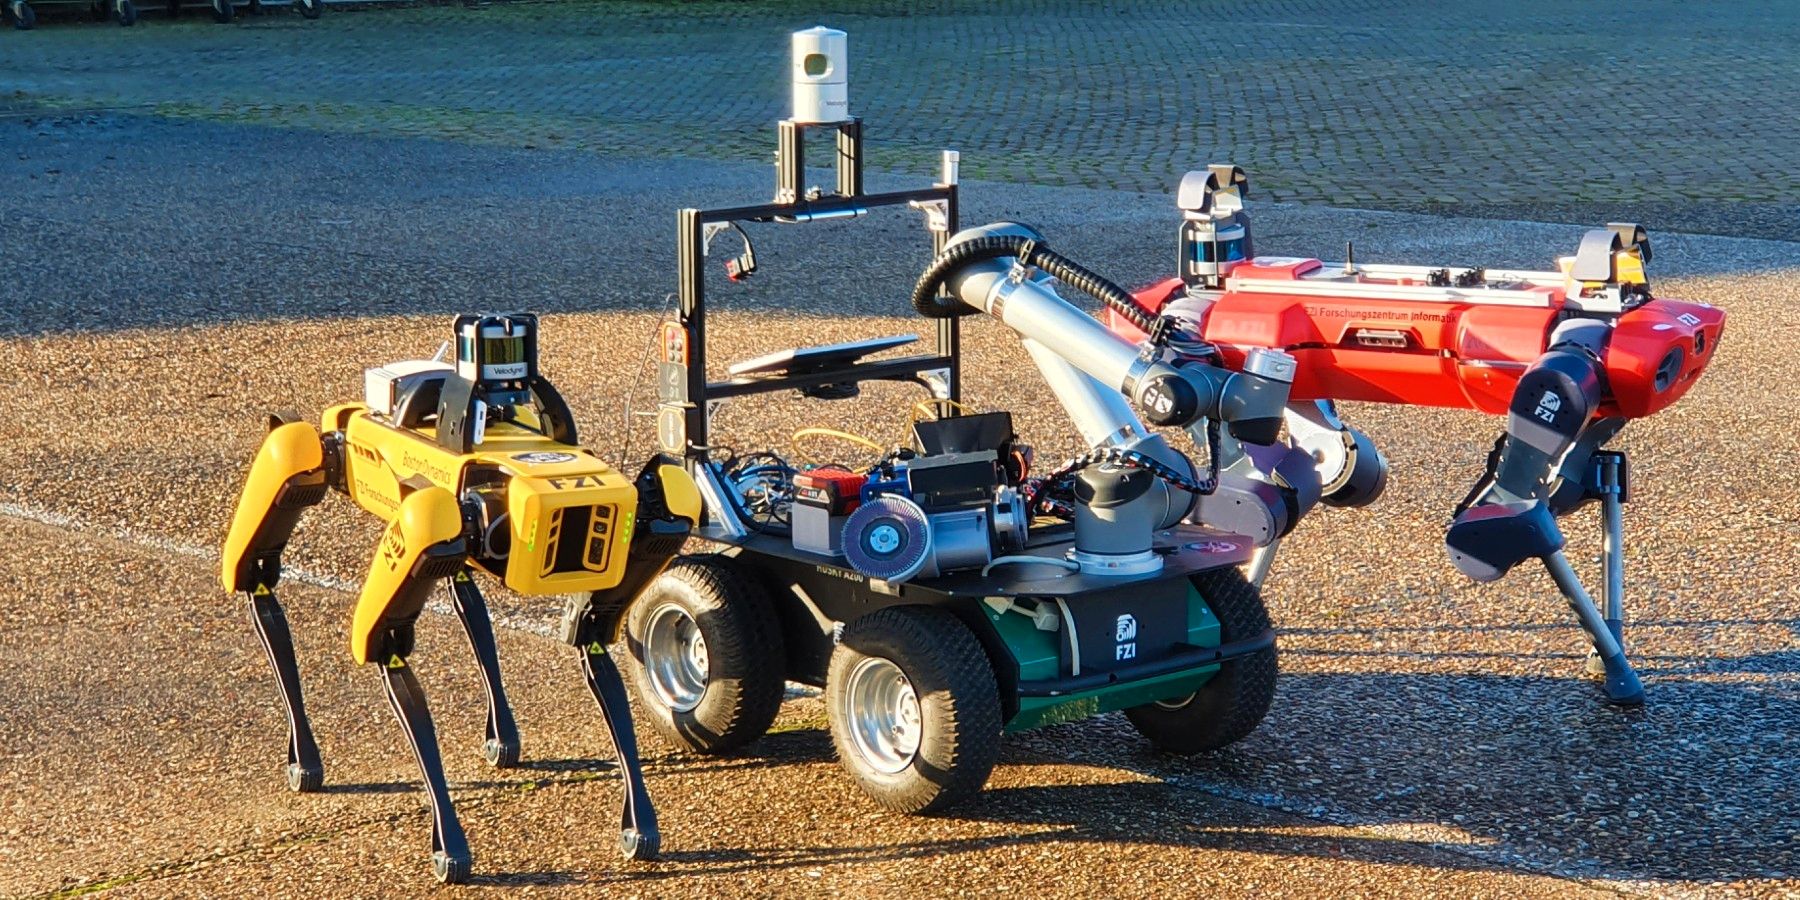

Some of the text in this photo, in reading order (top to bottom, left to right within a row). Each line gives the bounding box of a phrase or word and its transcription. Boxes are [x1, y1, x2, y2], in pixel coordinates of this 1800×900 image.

[1319, 307, 1409, 321] Forschungszentrum
[1410, 311, 1457, 323] Informatik
[1534, 405, 1555, 423] FZI
[547, 474, 606, 490] FZI
[1116, 642, 1136, 660] FZI
